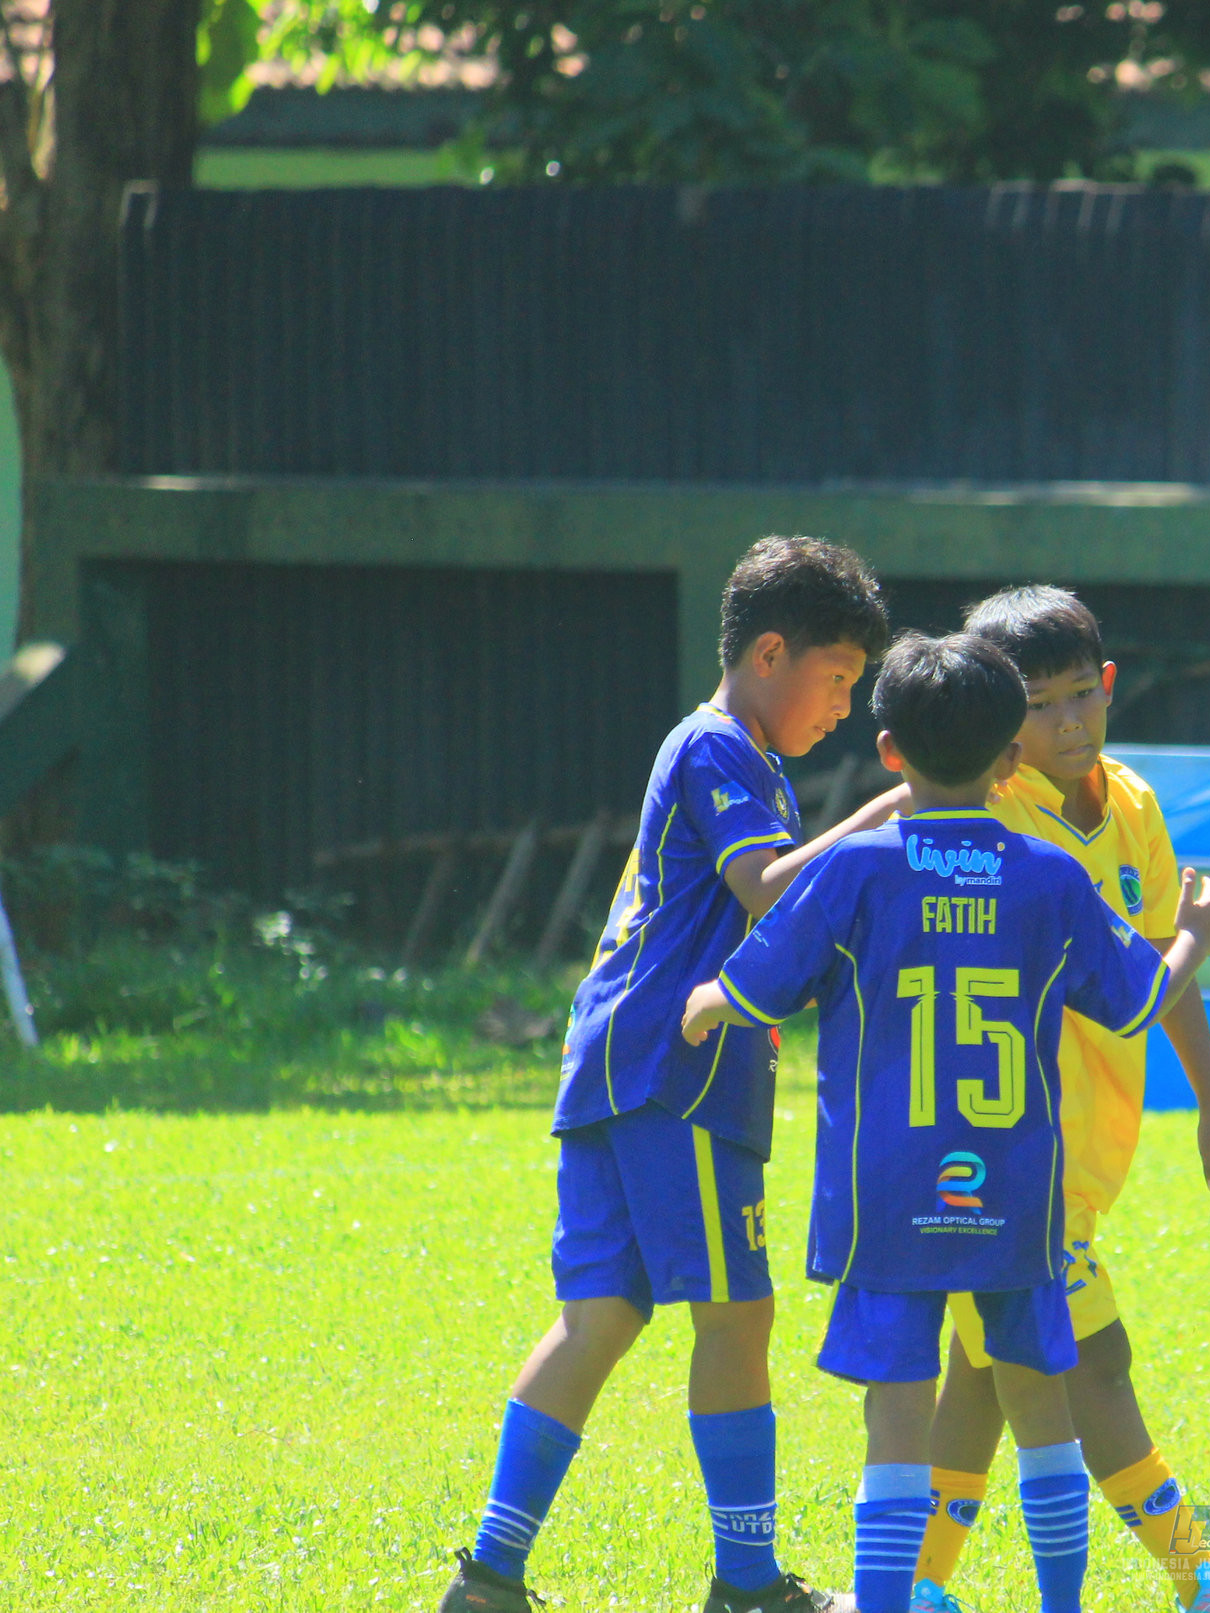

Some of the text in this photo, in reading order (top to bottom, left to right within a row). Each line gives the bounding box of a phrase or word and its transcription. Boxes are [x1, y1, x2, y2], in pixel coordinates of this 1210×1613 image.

[922, 896, 997, 935] FATIH
[896, 965, 1026, 1128] 15
[912, 1216, 1006, 1227] REZAM OPTICAL GROUP
